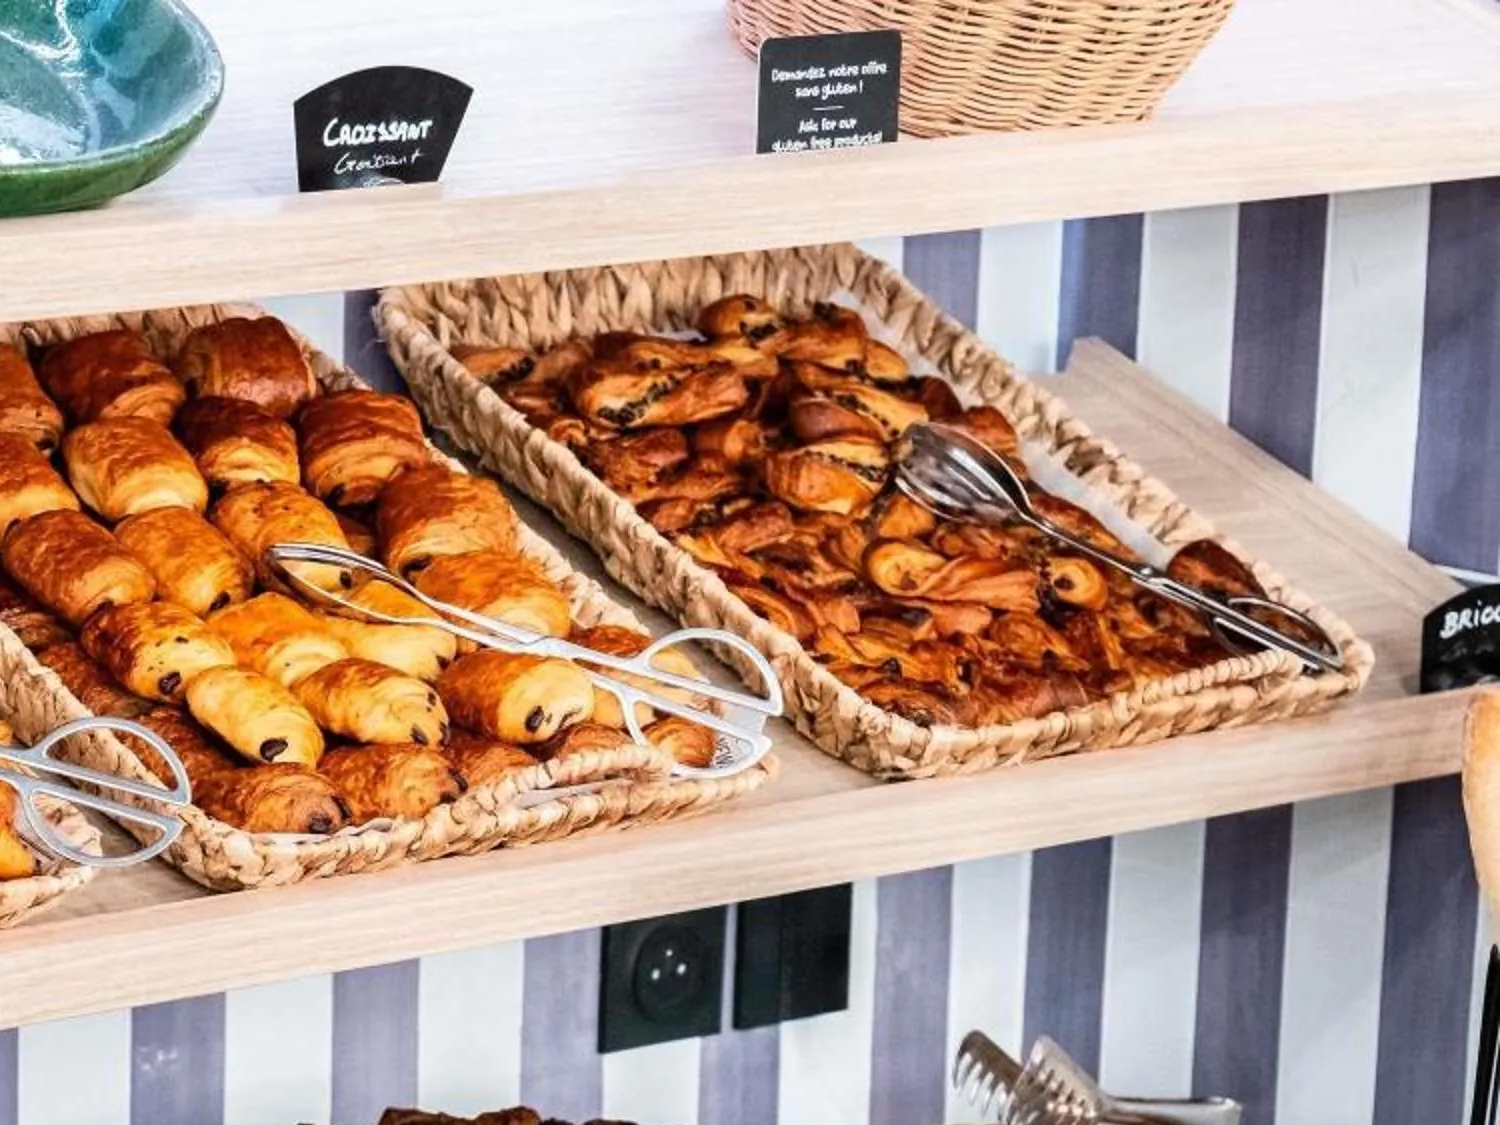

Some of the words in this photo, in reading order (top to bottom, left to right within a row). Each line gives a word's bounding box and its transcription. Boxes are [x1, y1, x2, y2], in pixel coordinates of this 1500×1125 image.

[323, 117, 433, 147] CROISSANT
[798, 118, 819, 134] Ask
[821, 117, 837, 131] for
[839, 118, 857, 129] our
